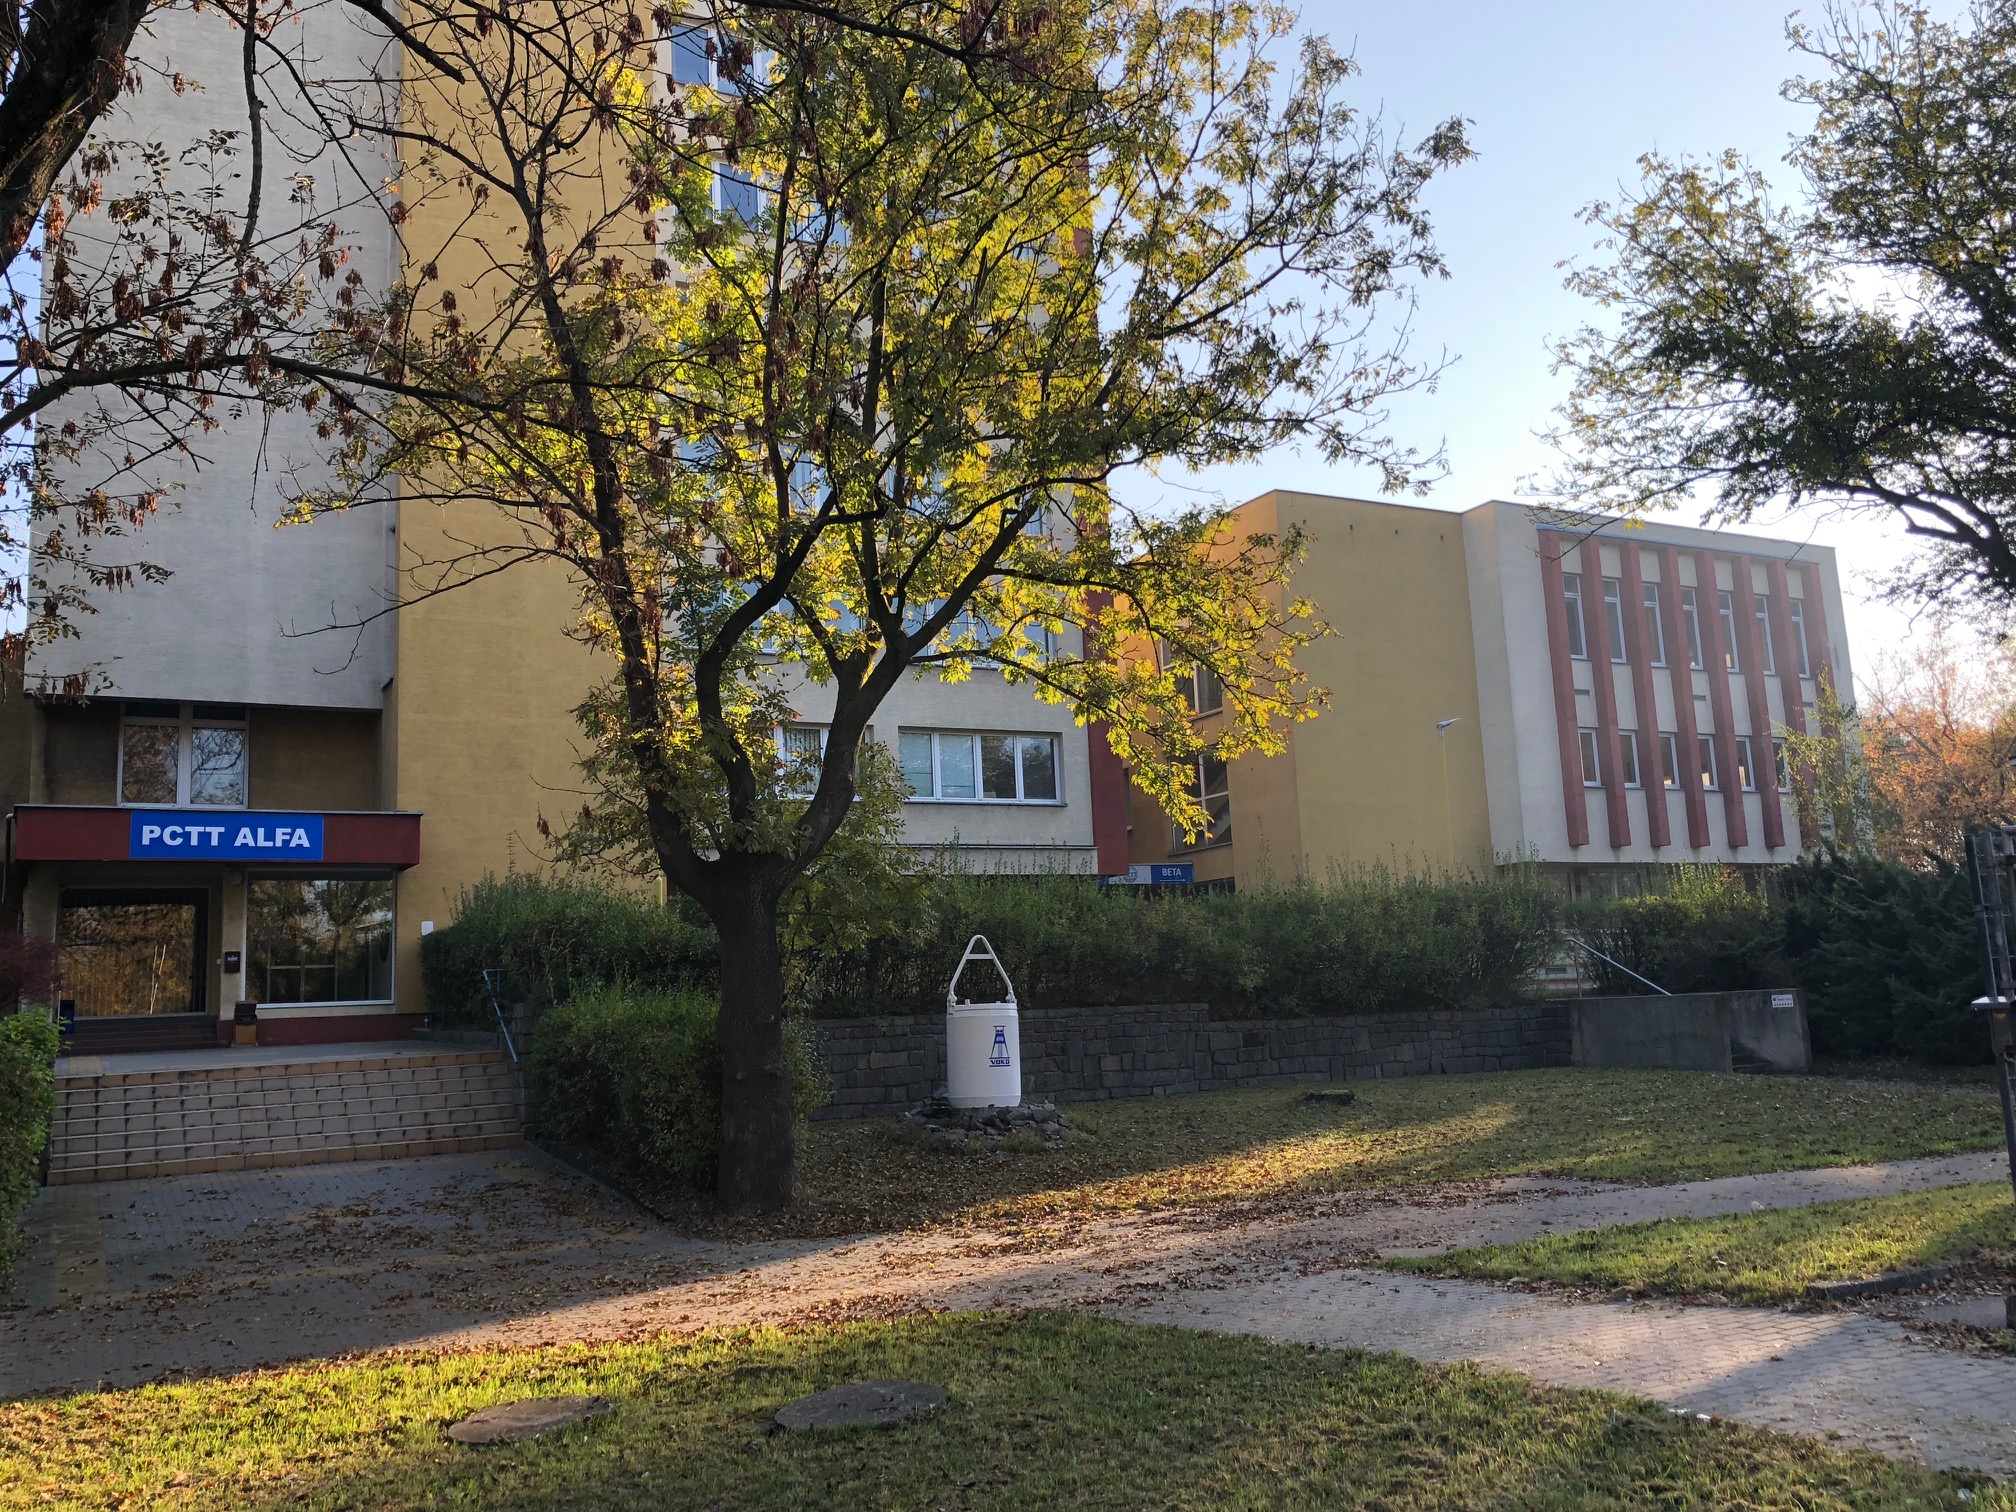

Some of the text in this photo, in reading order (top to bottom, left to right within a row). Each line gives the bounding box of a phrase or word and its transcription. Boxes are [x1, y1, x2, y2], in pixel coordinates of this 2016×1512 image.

[141, 825, 310, 847] PCTT ALFA
[1162, 867, 1182, 877] BETA
